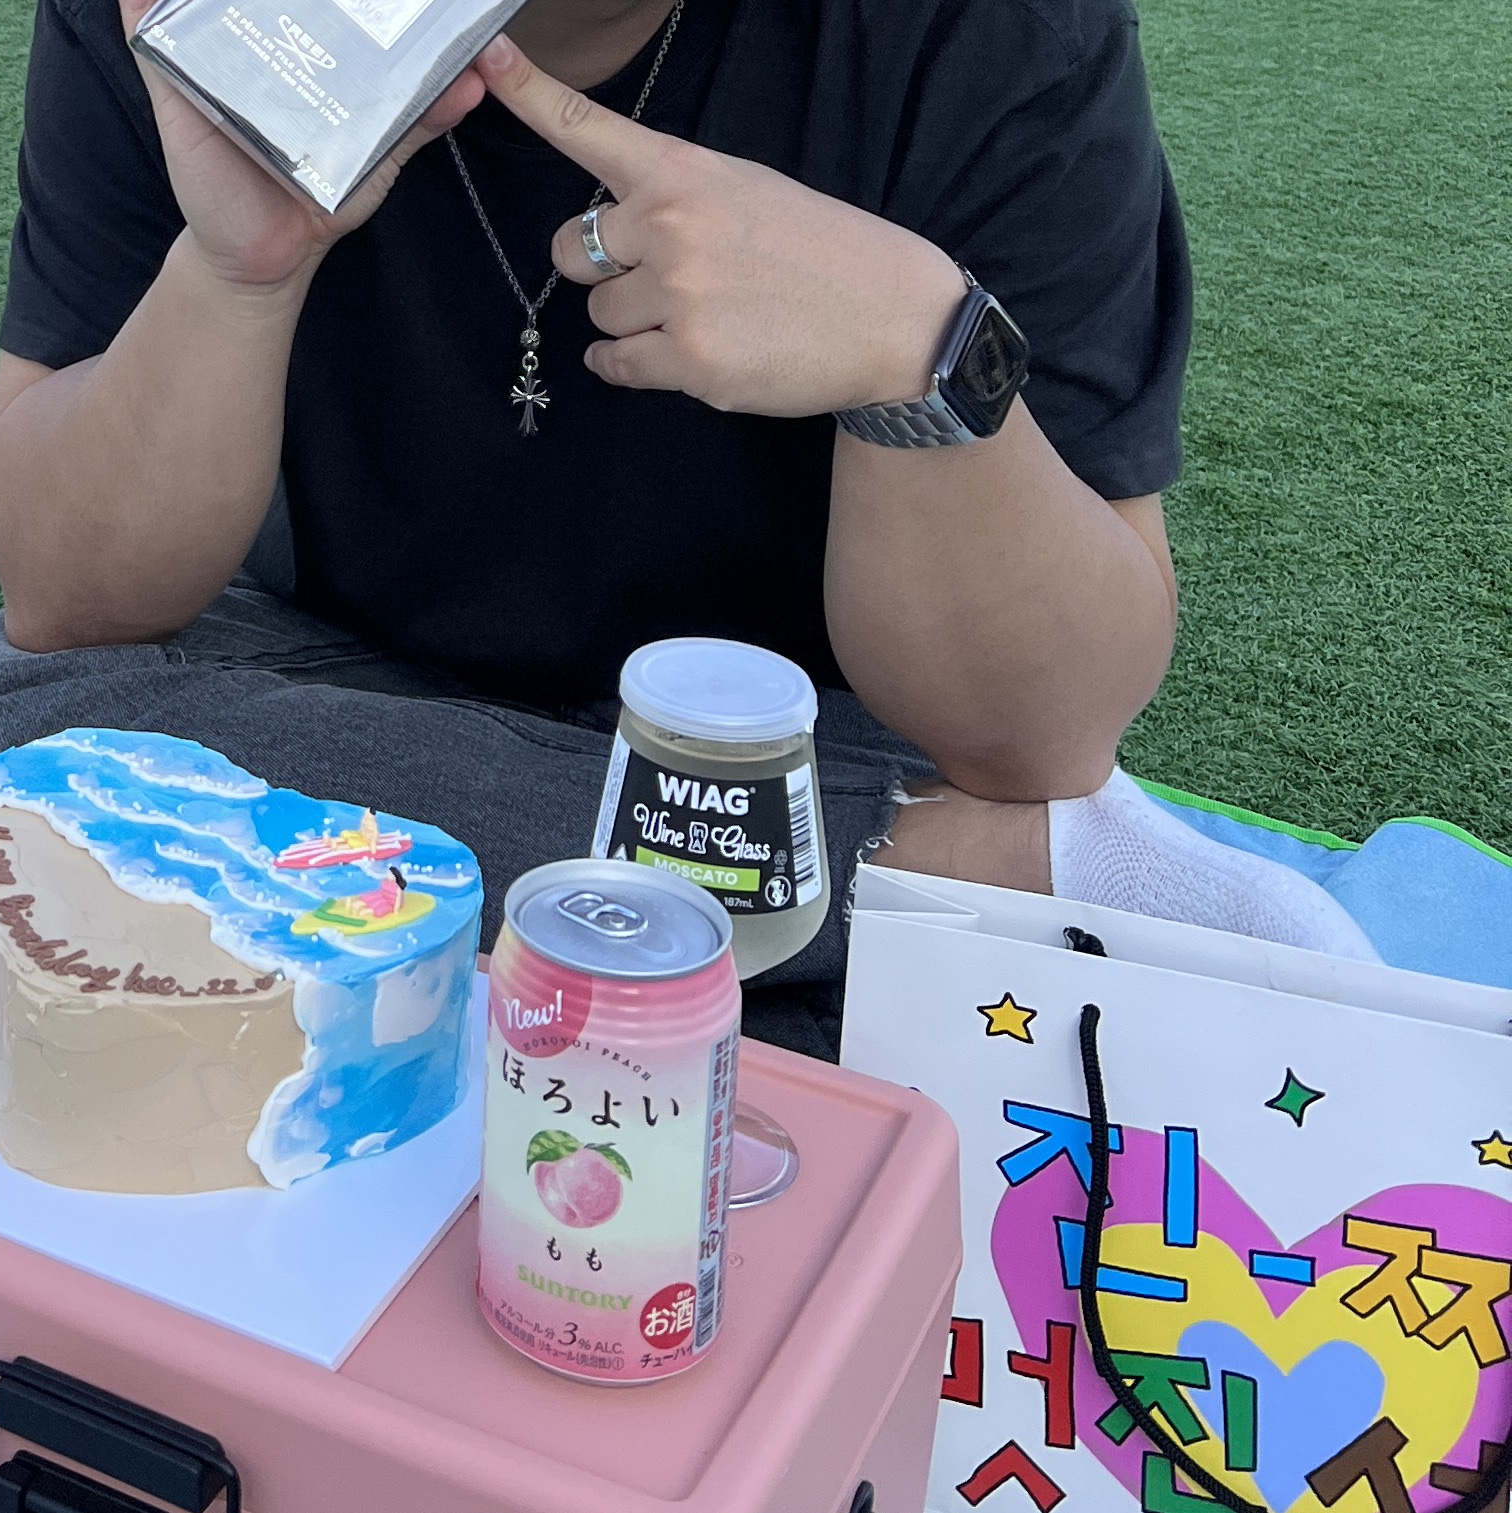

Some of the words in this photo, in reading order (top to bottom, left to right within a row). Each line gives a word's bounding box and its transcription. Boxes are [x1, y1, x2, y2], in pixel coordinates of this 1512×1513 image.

[270, 59, 281, 72] TO
[273, 14, 337, 76] CREED
[327, 96, 349, 120] 1760
[657, 772, 750, 816] WIAG
[633, 802, 686, 849] Wine
[710, 824, 772, 862] Glass
[653, 856, 739, 886] MOSCATO
[723, 896, 755, 909] 187mL
[502, 989, 564, 1030] New!
[522, 1036, 592, 1053] HOROYOI
[600, 1046, 653, 1082] PEACH
[502, 1047, 680, 1129] ほろよい
[546, 1236, 603, 1272] もも
[517, 1263, 635, 1312] SUNTORY
[644, 1295, 696, 1337] お酒
[639, 1341, 695, 1369] チューハイ
